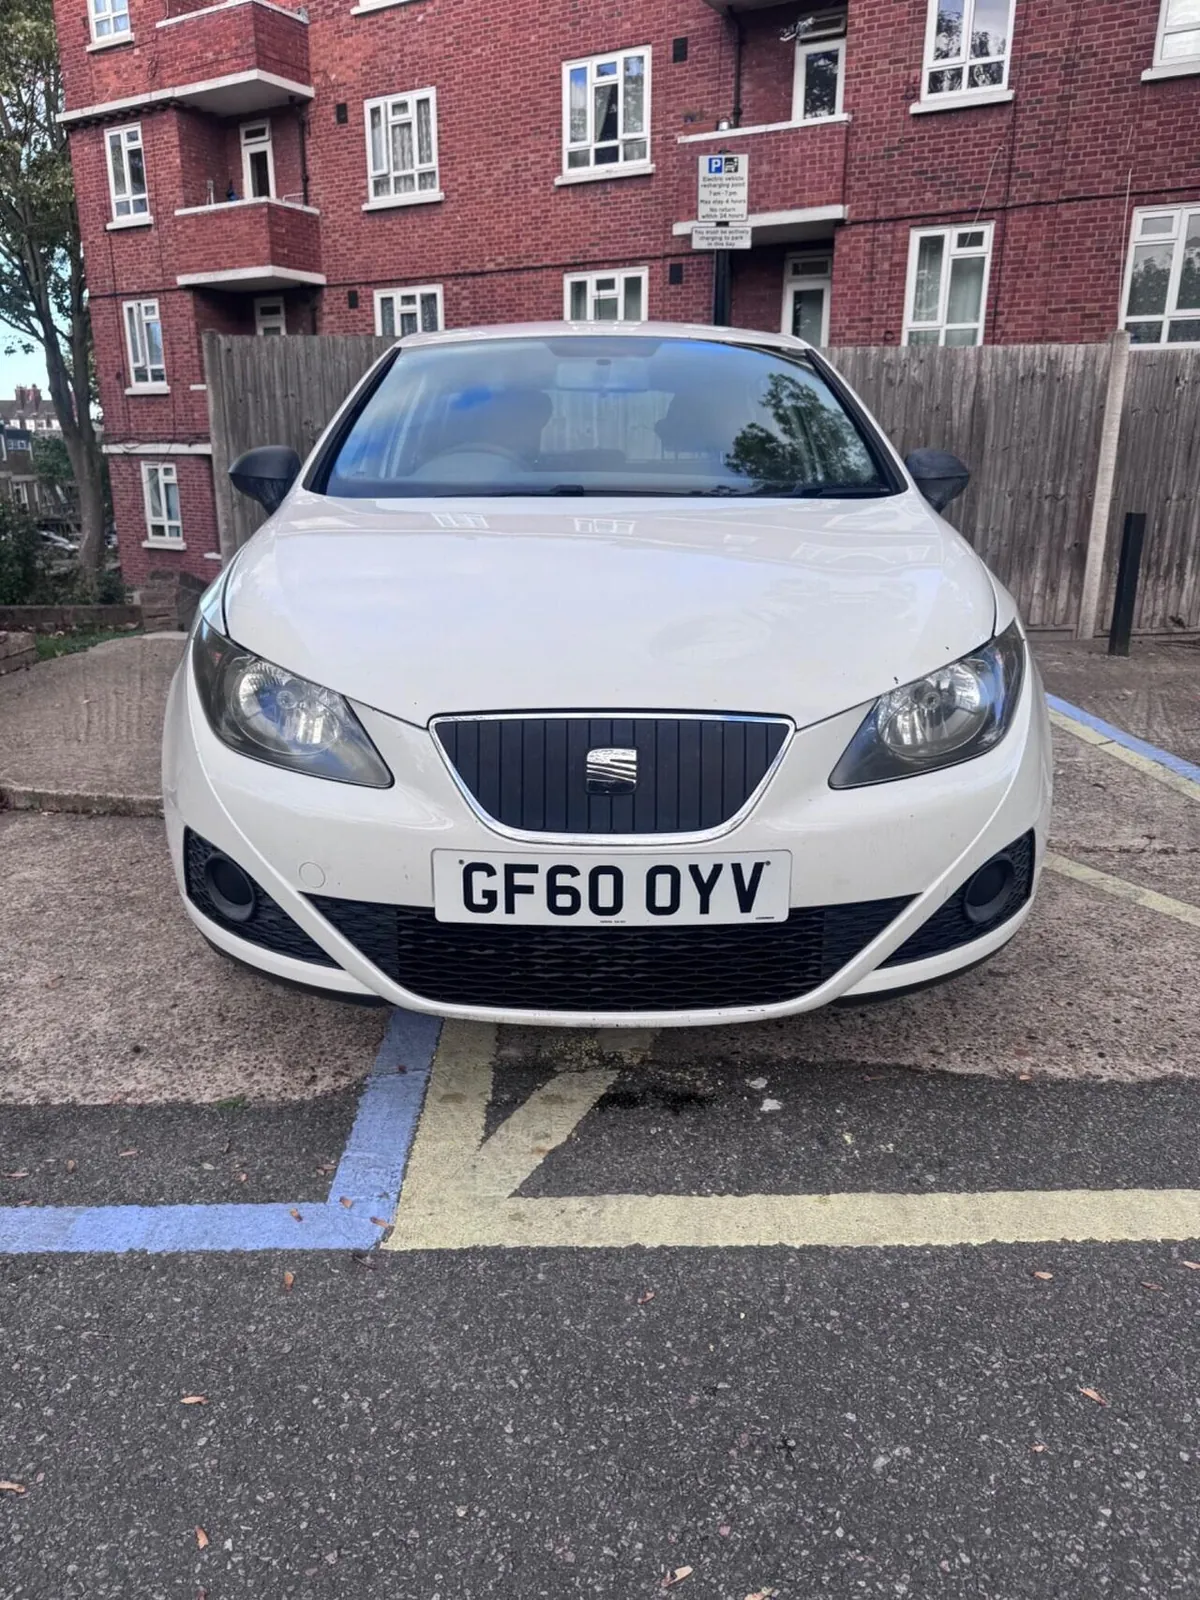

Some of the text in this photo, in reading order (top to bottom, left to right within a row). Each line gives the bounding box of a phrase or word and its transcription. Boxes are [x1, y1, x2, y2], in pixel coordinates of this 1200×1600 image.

[711, 158, 721, 172] P
[462, 862, 765, 916] GF60 OYV
